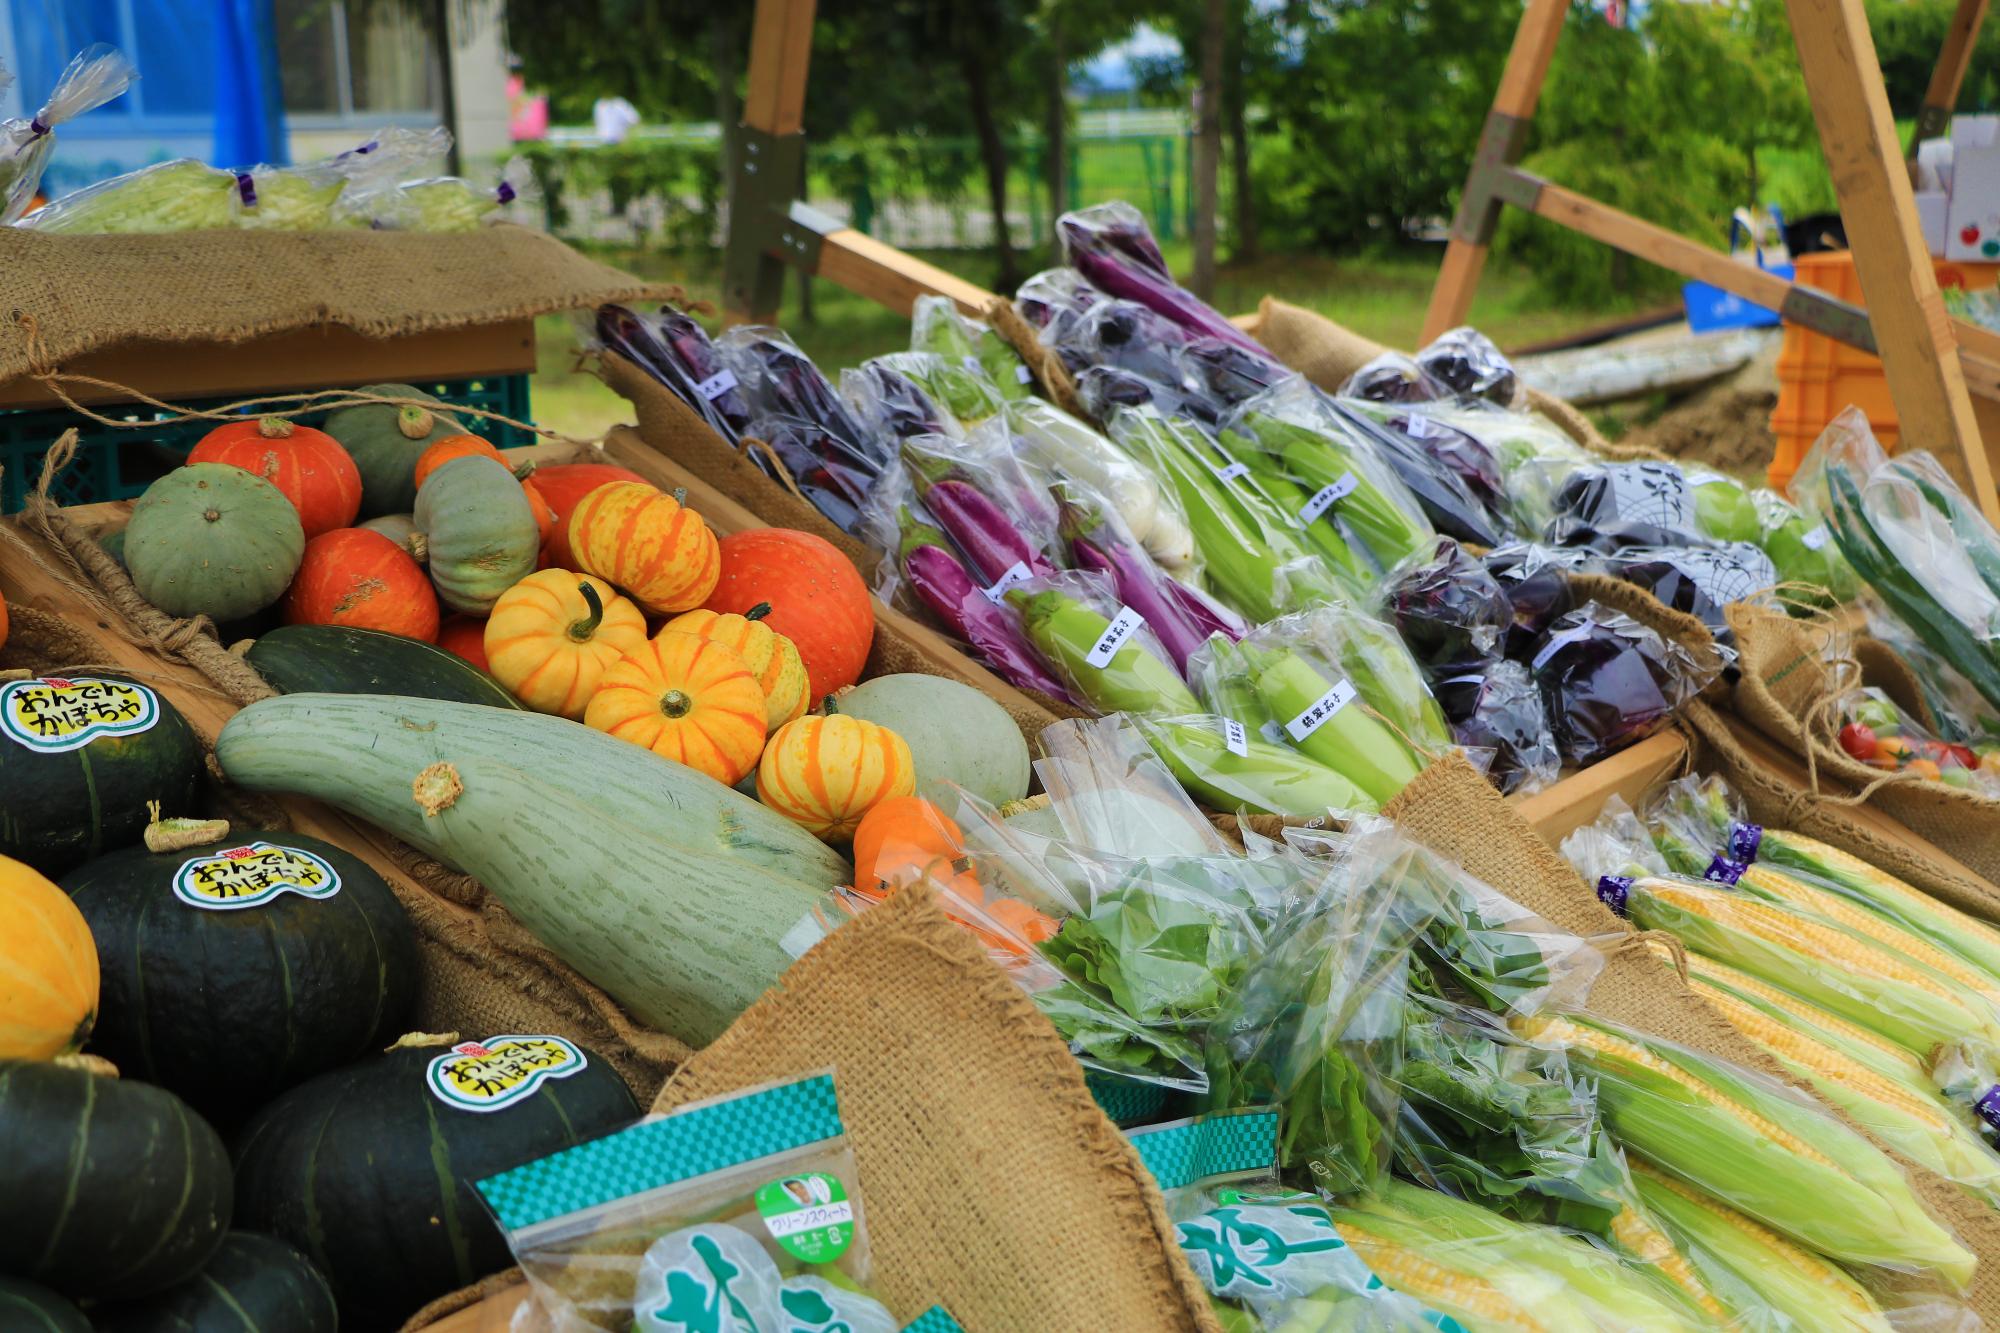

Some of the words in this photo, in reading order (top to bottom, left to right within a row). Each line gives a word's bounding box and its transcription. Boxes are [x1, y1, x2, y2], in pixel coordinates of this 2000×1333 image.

[1099, 619, 1129, 654] 翡翠茄子
[13, 682, 133, 713] おんでん
[1301, 692, 1341, 728] 翡翠茄子
[189, 850, 314, 883] おんでん
[442, 1040, 548, 1083] おんでん
